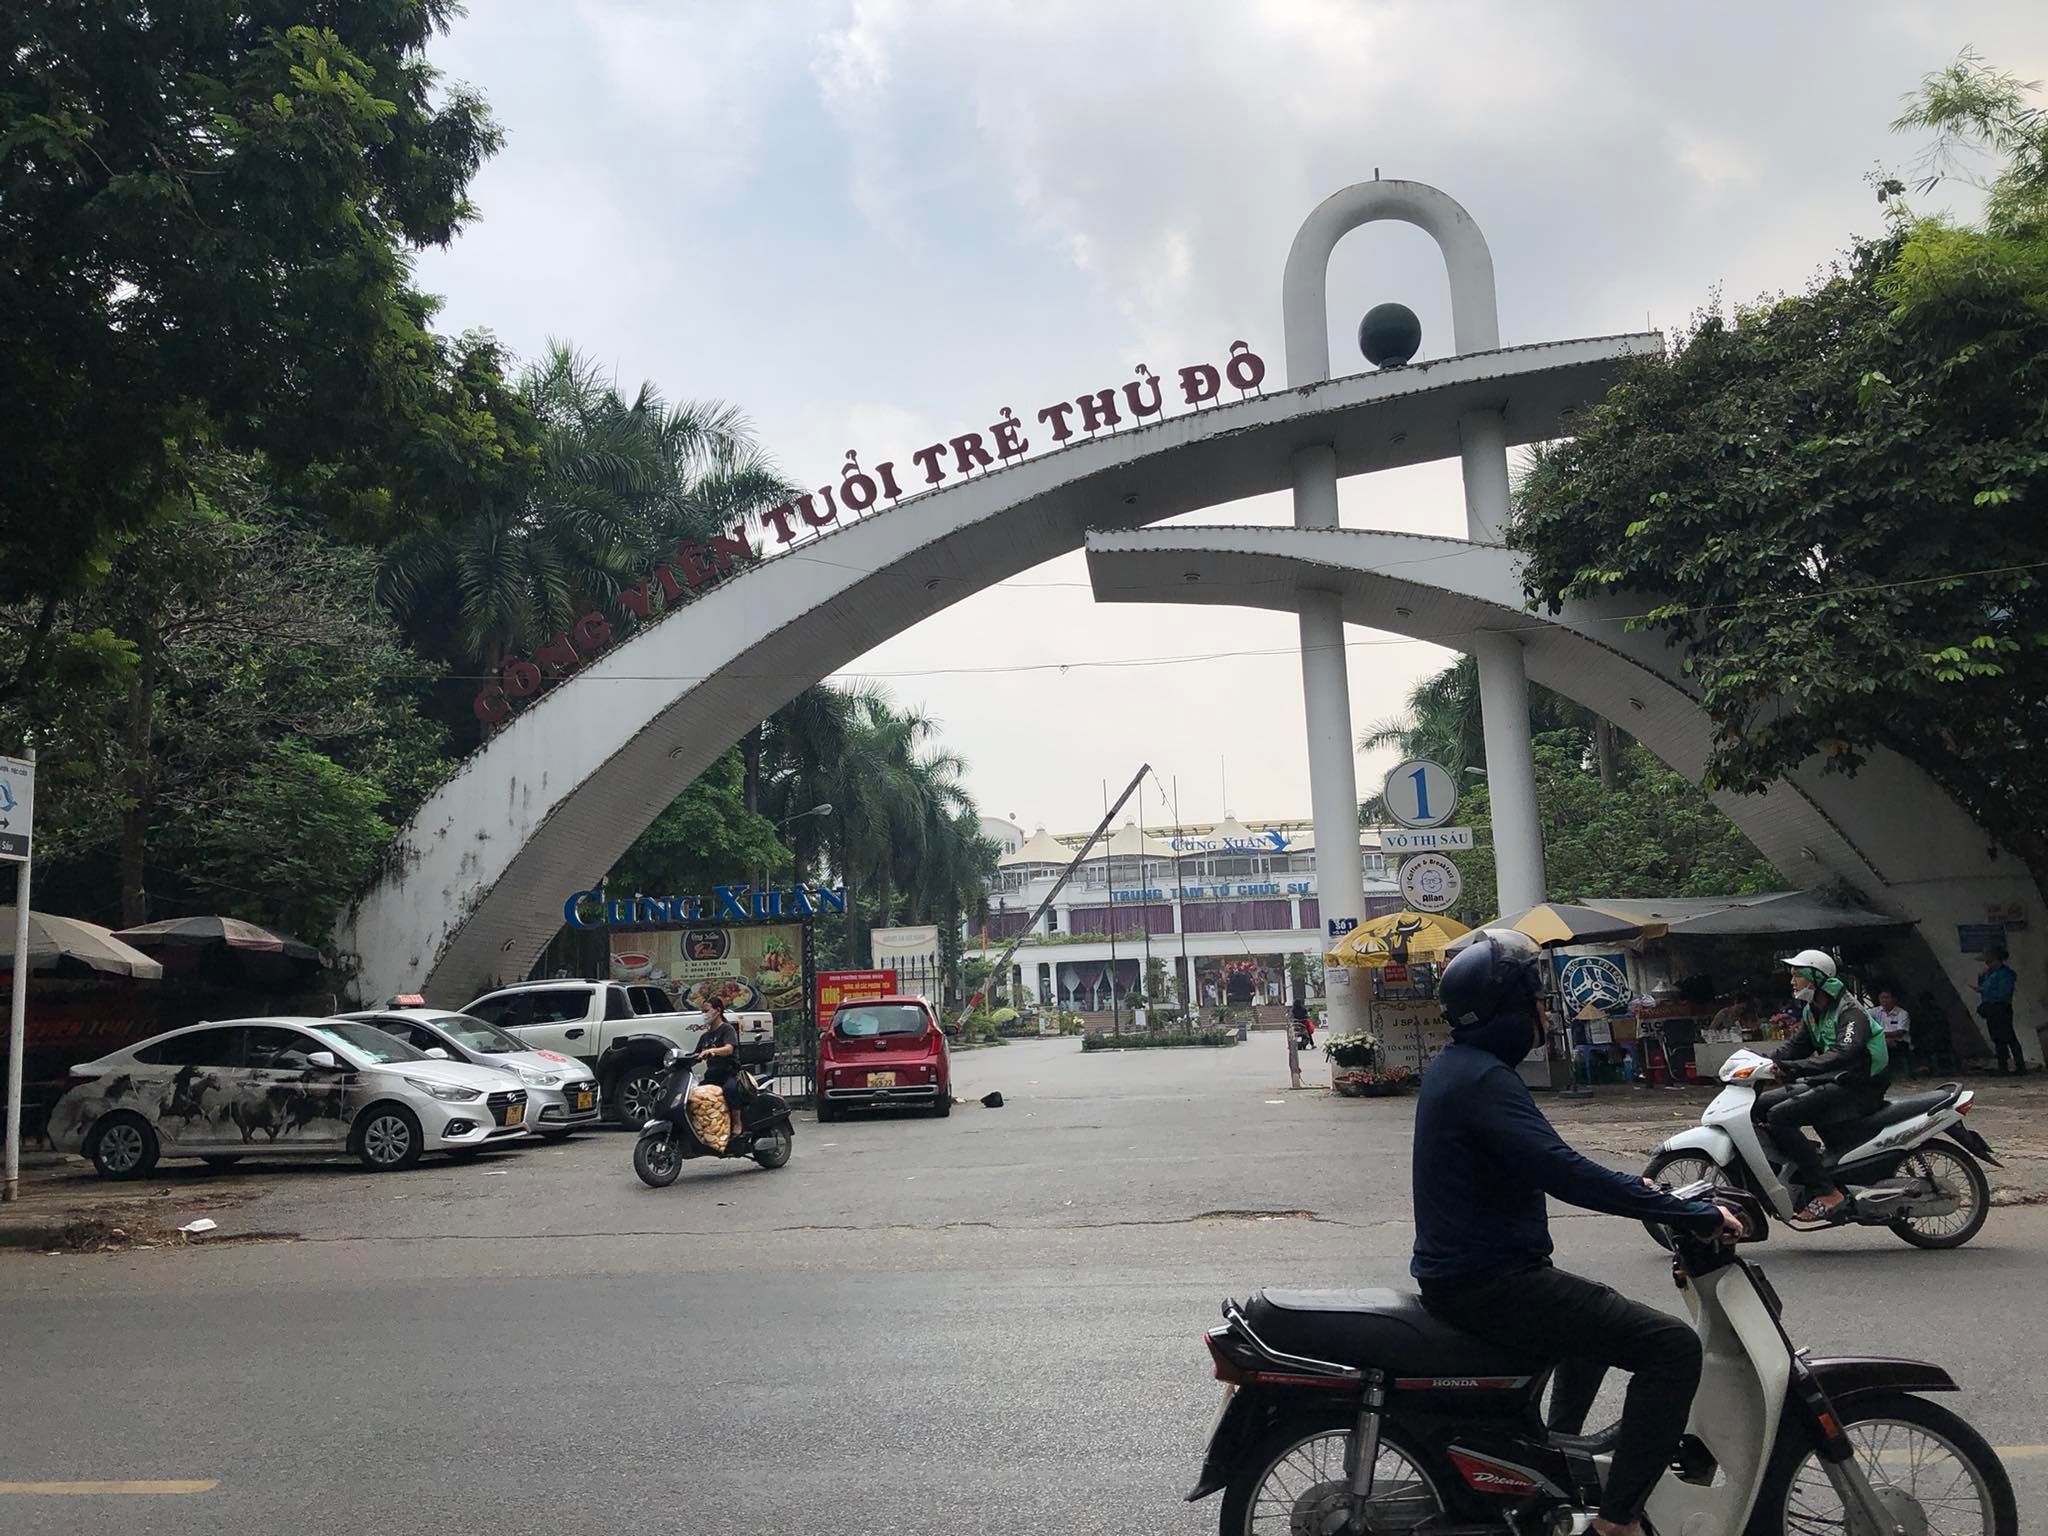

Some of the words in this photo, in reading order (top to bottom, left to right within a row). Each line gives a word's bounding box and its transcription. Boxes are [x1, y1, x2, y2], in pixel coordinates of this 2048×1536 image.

[474, 611, 611, 721] CÔNG
[617, 526, 752, 619] VIÊN
[761, 449, 903, 544] TUỔI
[913, 406, 1029, 484] TRẺ
[1038, 363, 1163, 441] THỦ
[1178, 340, 1265, 404] ĐÔ
[1407, 767, 1436, 820] 1
[1387, 834, 1408, 847] VÕ
[1411, 835, 1436, 848] THỊ
[1440, 831, 1468, 845] SÁU
[1422, 894, 1444, 902] Allan
[1432, 1379, 1479, 1387] HONDA
[1472, 1472, 1532, 1486] Dream
